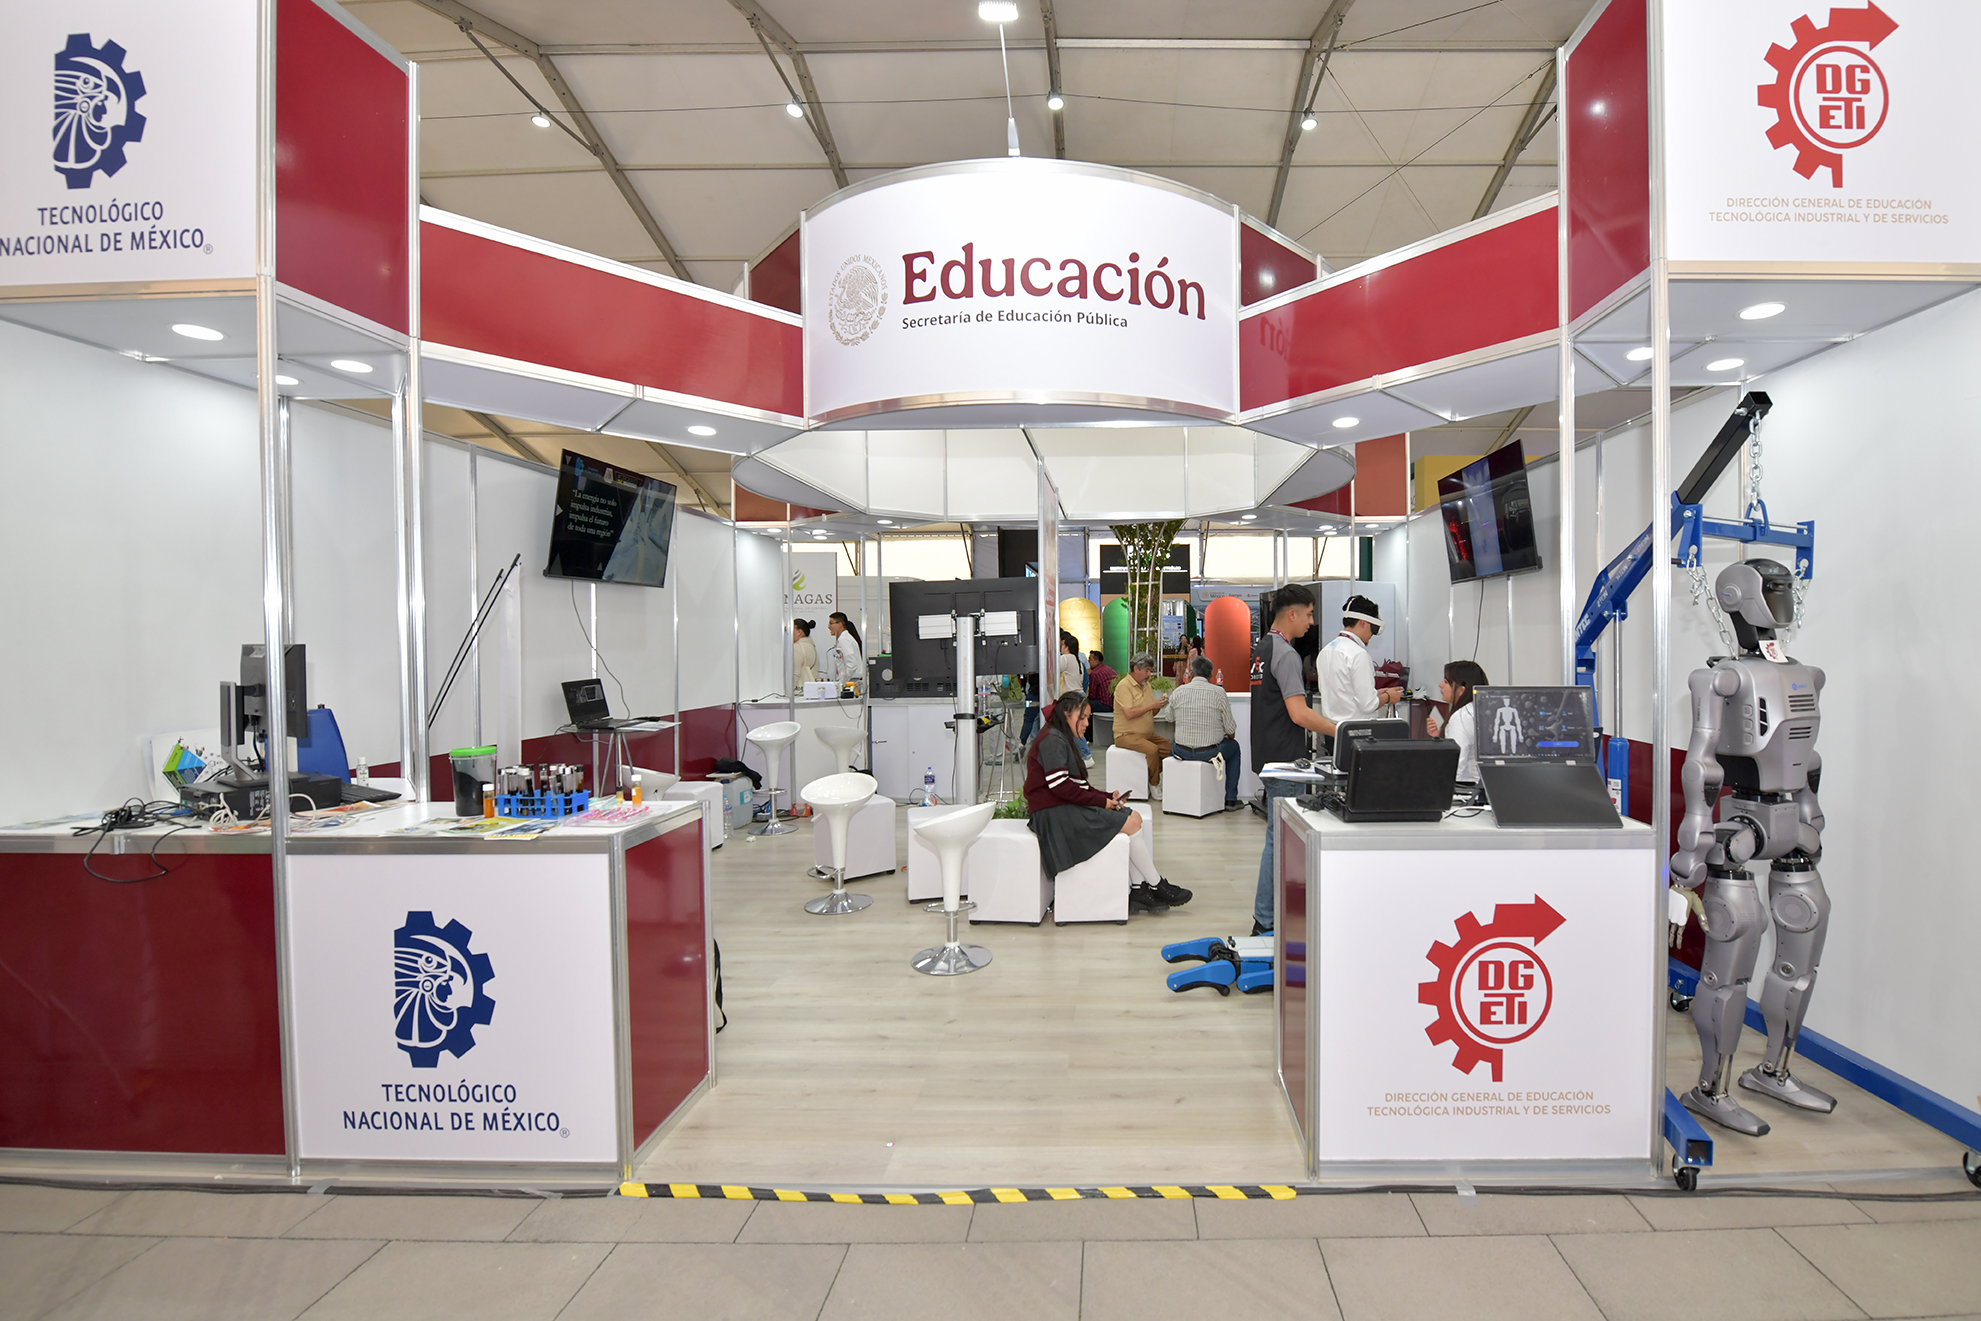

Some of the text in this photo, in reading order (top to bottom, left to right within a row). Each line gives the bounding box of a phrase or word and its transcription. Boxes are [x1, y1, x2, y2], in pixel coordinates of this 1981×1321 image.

[37, 198, 164, 226] TECNOLÓGICO
[1726, 196, 1932, 210] DIRECCIÓN GENERAL DE EDUCACIÓN
[1709, 210, 1949, 224] TECNOLÓGICA INDUSTRIAL Y DE SERVICIOS
[0, 233, 93, 257] NACIONAL
[100, 232, 123, 252] DE
[828, 270, 841, 306] ESTADOS
[863, 254, 888, 291] MEXICANOS
[902, 242, 1206, 320] Educación
[902, 310, 1128, 329] Secretaría de Educación Pública
[381, 1078, 517, 1103] TECNOLÓGICO
[1385, 1089, 1594, 1103] DIRECCIÓN GENERAL DE EDUCACIÓN
[343, 1110, 444, 1131] NACIONAL
[450, 1112, 475, 1131] DE
[1367, 1104, 1611, 1116] TECNOLÓGICA INDUSTRIAL Y DE SERVICIOS
